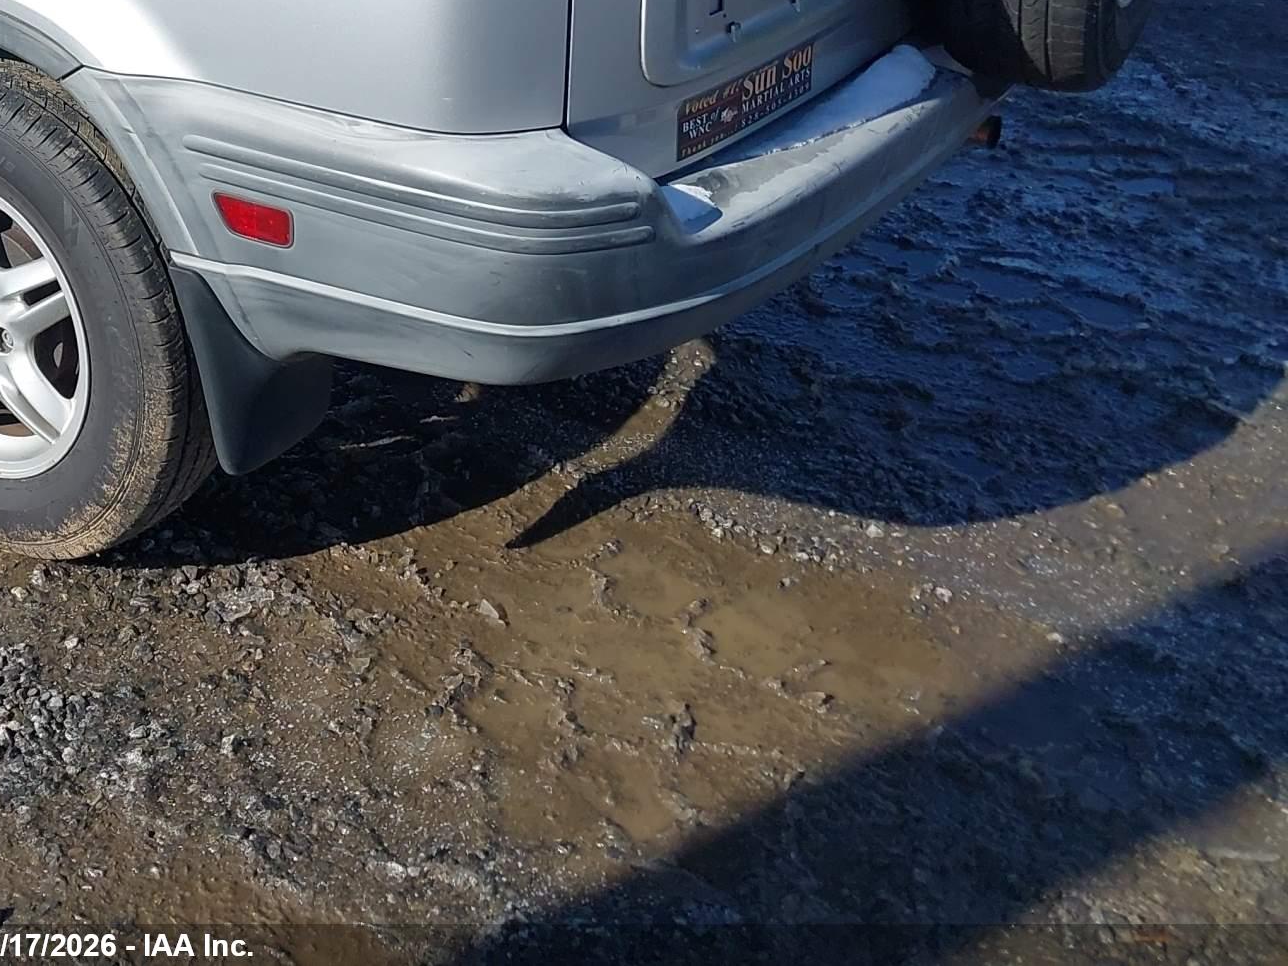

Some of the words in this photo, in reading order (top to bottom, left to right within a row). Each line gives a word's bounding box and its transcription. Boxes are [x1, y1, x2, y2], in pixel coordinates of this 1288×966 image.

[742, 59, 779, 102] Sun
[782, 44, 813, 80] Soo
[685, 89, 719, 116] Voted
[742, 84, 785, 113] MARTIAL
[789, 67, 811, 87] ARTS
[682, 112, 708, 133] BEST
[688, 121, 712, 140] WNC
